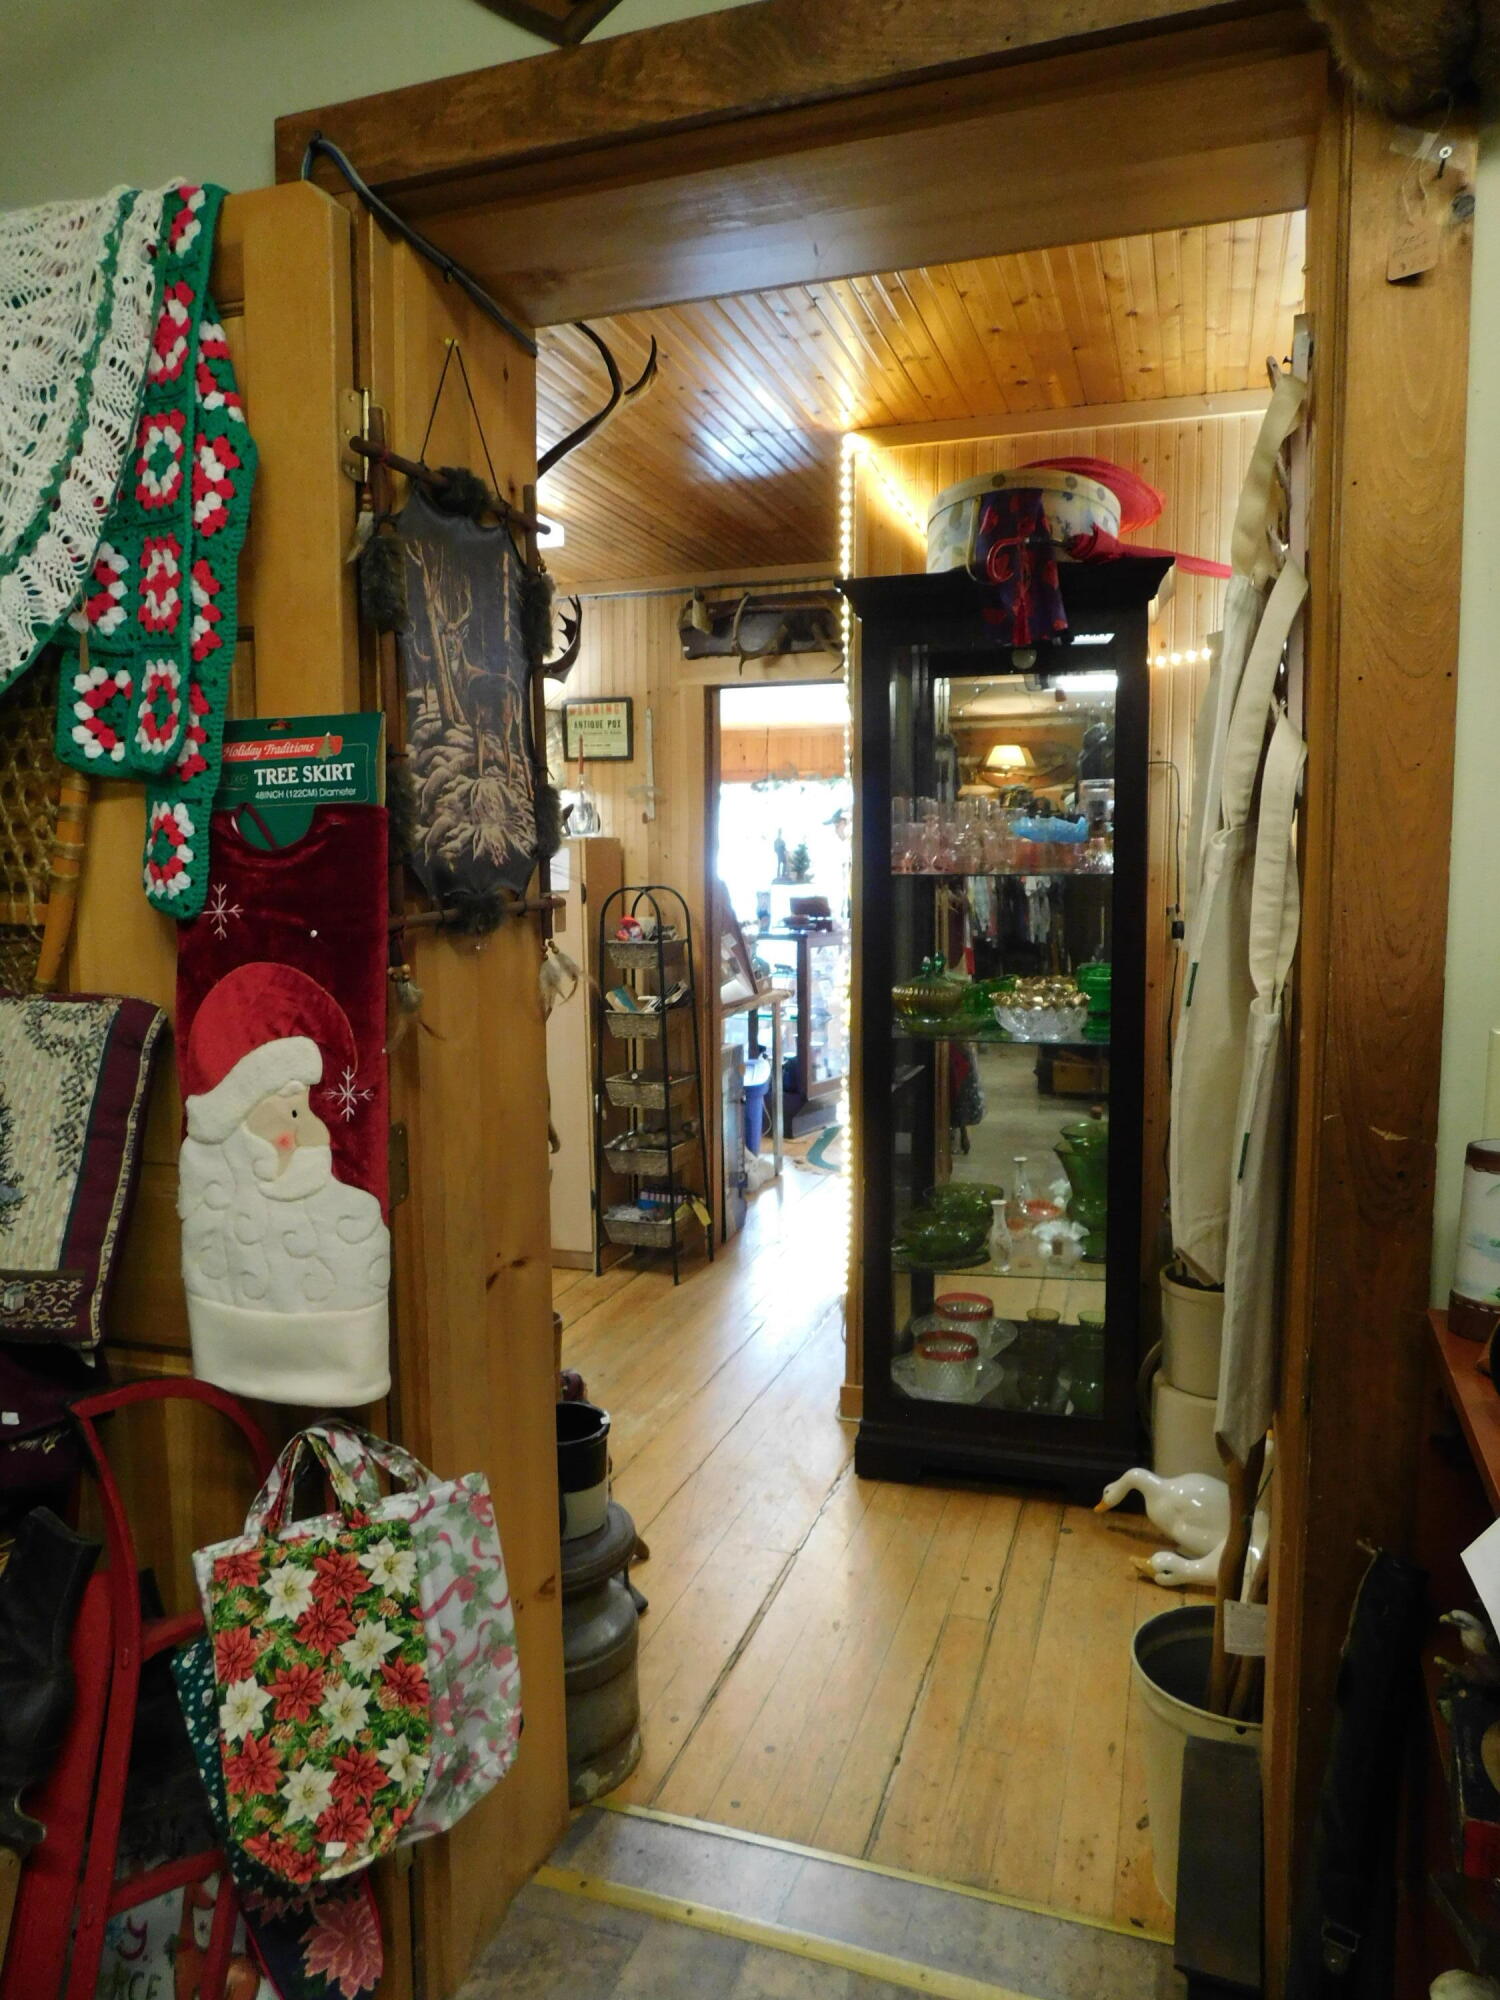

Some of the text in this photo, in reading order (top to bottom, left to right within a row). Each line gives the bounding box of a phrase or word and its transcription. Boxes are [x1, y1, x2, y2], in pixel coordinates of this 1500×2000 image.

[574, 720, 603, 729] ANTIQUE
[223, 741, 315, 760] Holiday Traditions
[254, 763, 356, 786] TREE SKIRT
[319, 787, 356, 797] Diameter
